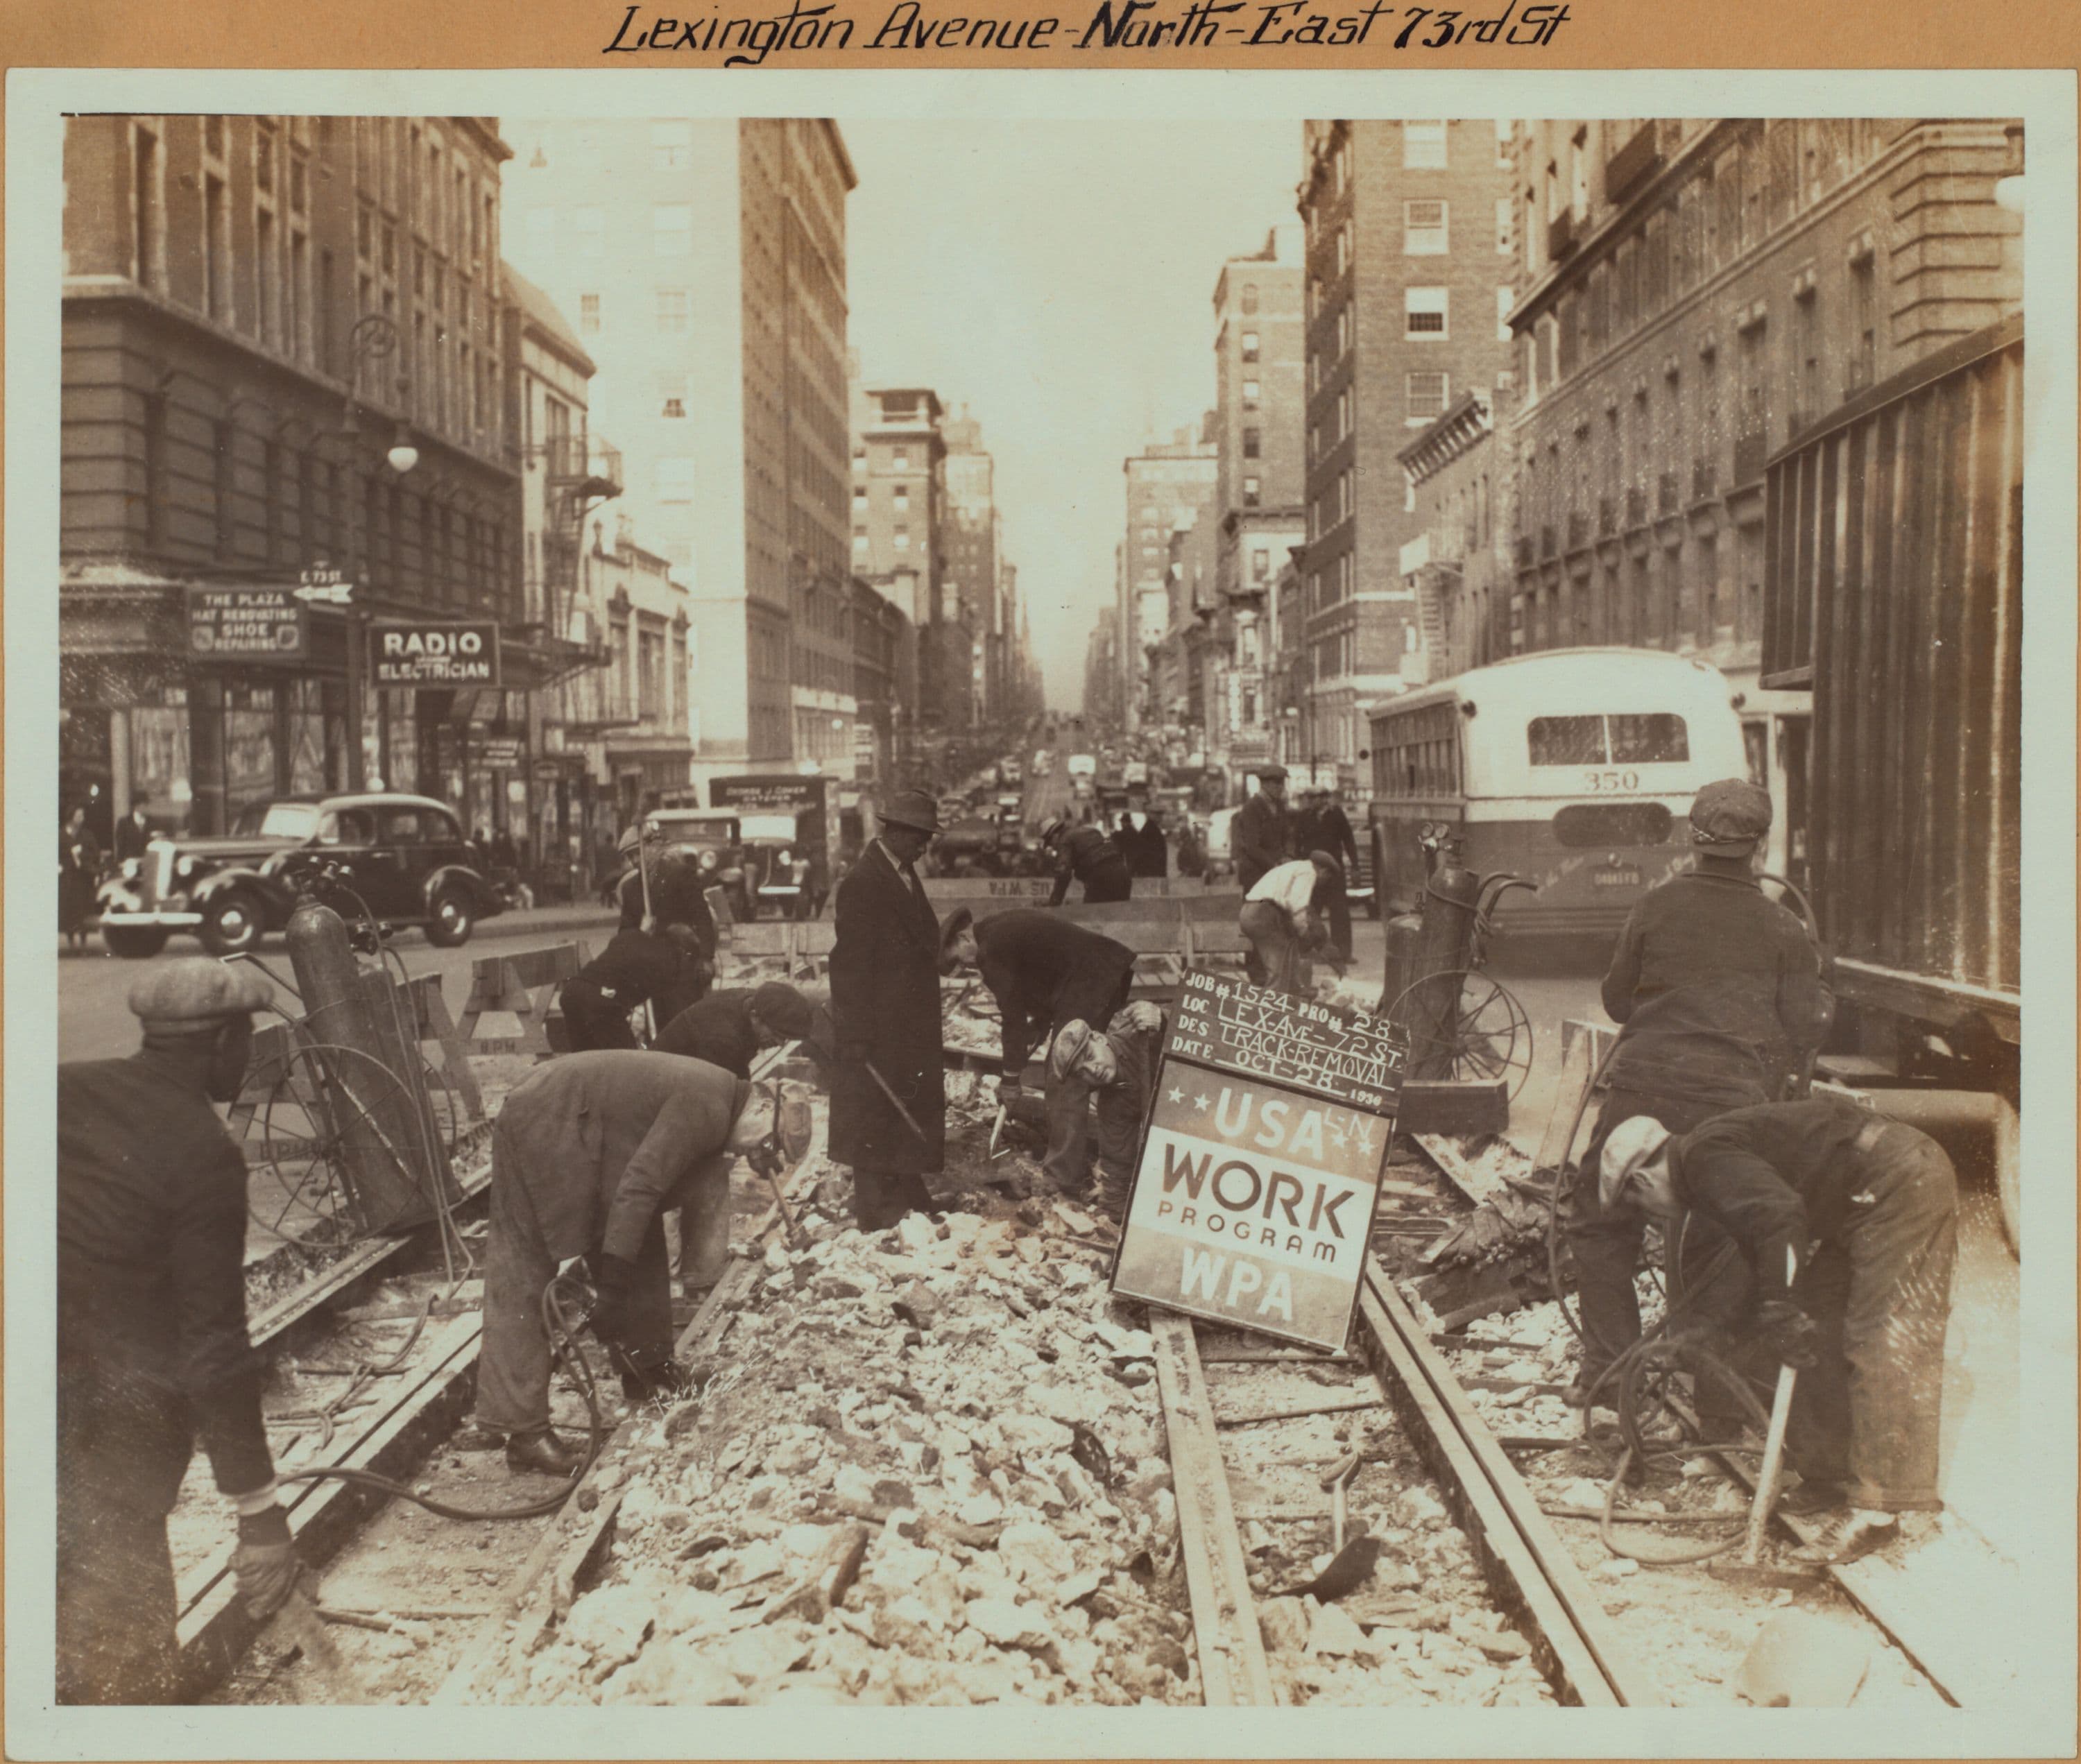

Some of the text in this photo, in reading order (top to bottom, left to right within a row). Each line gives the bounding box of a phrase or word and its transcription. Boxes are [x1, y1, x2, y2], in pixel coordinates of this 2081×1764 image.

[603, 0, 854, 67] Lexington
[1394, 0, 1507, 49] 73rd
[1510, 3, 1571, 46] St
[204, 593, 285, 606] THE PLAZA
[192, 608, 298, 622] HAT RENOVATING
[222, 623, 268, 637] SHOE
[214, 637, 277, 651] REPAIRING
[384, 631, 482, 656] RADIO
[378, 662, 490, 680] ELECTRICIAN
[1584, 771, 1638, 791] 350
[1182, 994, 1210, 1014] LOC
[1234, 982, 1295, 1013] 1524
[1353, 1012, 1391, 1038] 28
[1178, 1014, 1210, 1037] DES
[1171, 1036, 1213, 1059] DATE
[1350, 1088, 1382, 1106] 1936
[1215, 1087, 1324, 1161] USA
[1163, 1142, 1355, 1239] WORK
[1158, 1200, 1336, 1262] PROGRAM
[1180, 1246, 1292, 1321] WPA
